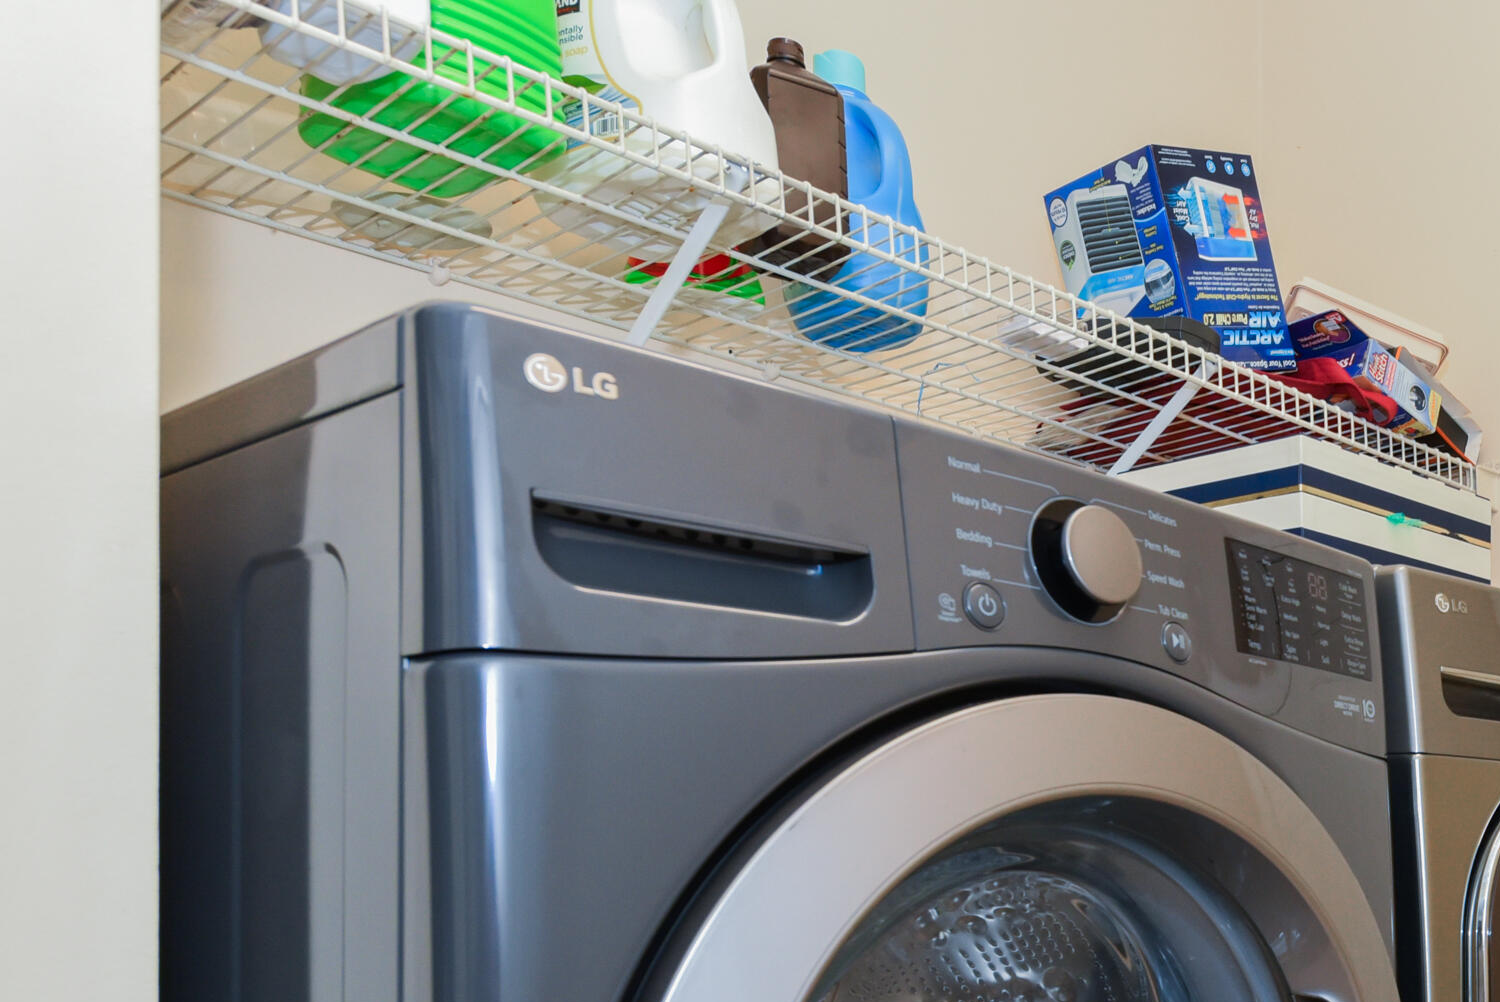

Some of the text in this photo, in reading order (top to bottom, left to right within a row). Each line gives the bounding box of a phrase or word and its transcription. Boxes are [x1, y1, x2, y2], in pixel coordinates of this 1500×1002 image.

[1203, 311, 1282, 328] AIR Pure Chill 2.0
[1223, 329, 1284, 346] ARCTIC
[1269, 360, 1283, 368] Your
[1283, 359, 1297, 368] Cool
[572, 365, 619, 400] LG
[948, 456, 981, 473] Normal
[952, 492, 1003, 515] Heavy Duty
[955, 527, 993, 548] Bedding
[960, 564, 992, 581] Towels
[1158, 604, 1189, 620] Tub Clean
[1451, 599, 1468, 614] LG
